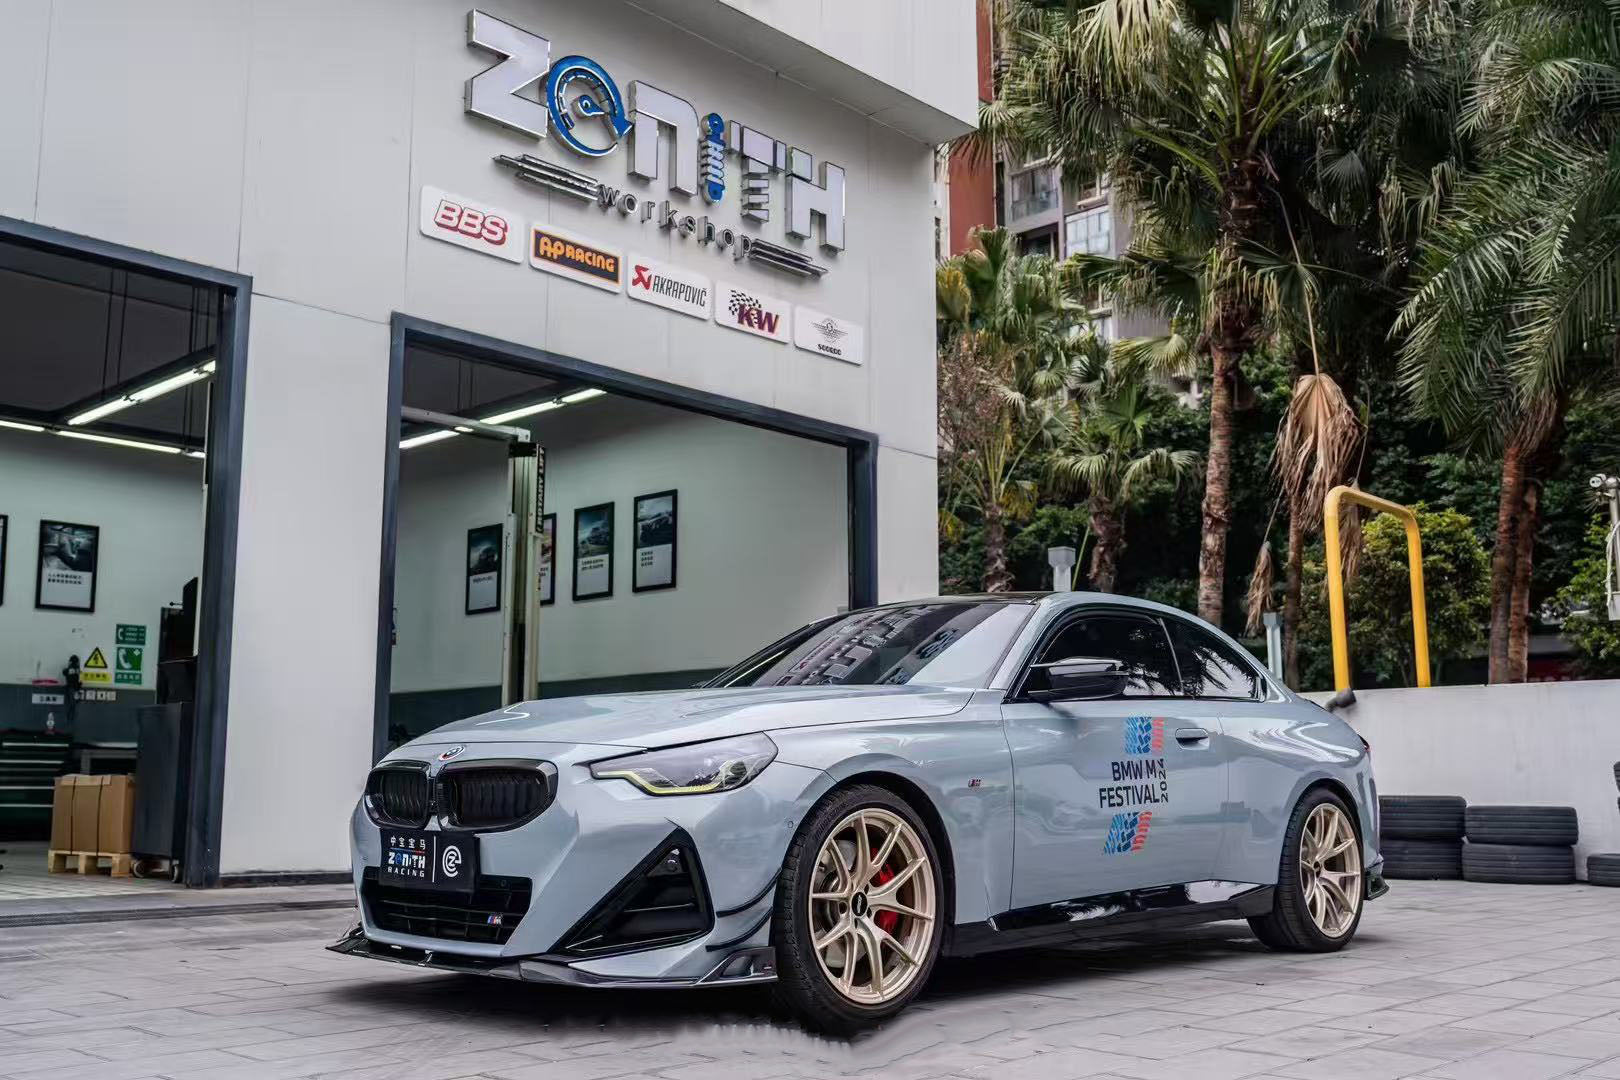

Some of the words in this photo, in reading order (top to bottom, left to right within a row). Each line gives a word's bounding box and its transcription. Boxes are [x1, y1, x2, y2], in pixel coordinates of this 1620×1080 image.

[434, 199, 509, 246] BBS
[597, 183, 752, 261] workshop
[566, 245, 615, 273] RACING
[737, 303, 780, 334] KW
[1111, 760, 1142, 782] BMW
[1145, 759, 1157, 780] M
[1158, 758, 1169, 803] 2024
[1099, 783, 1160, 808] FESTIVAL
[387, 866, 425, 878] RACING
